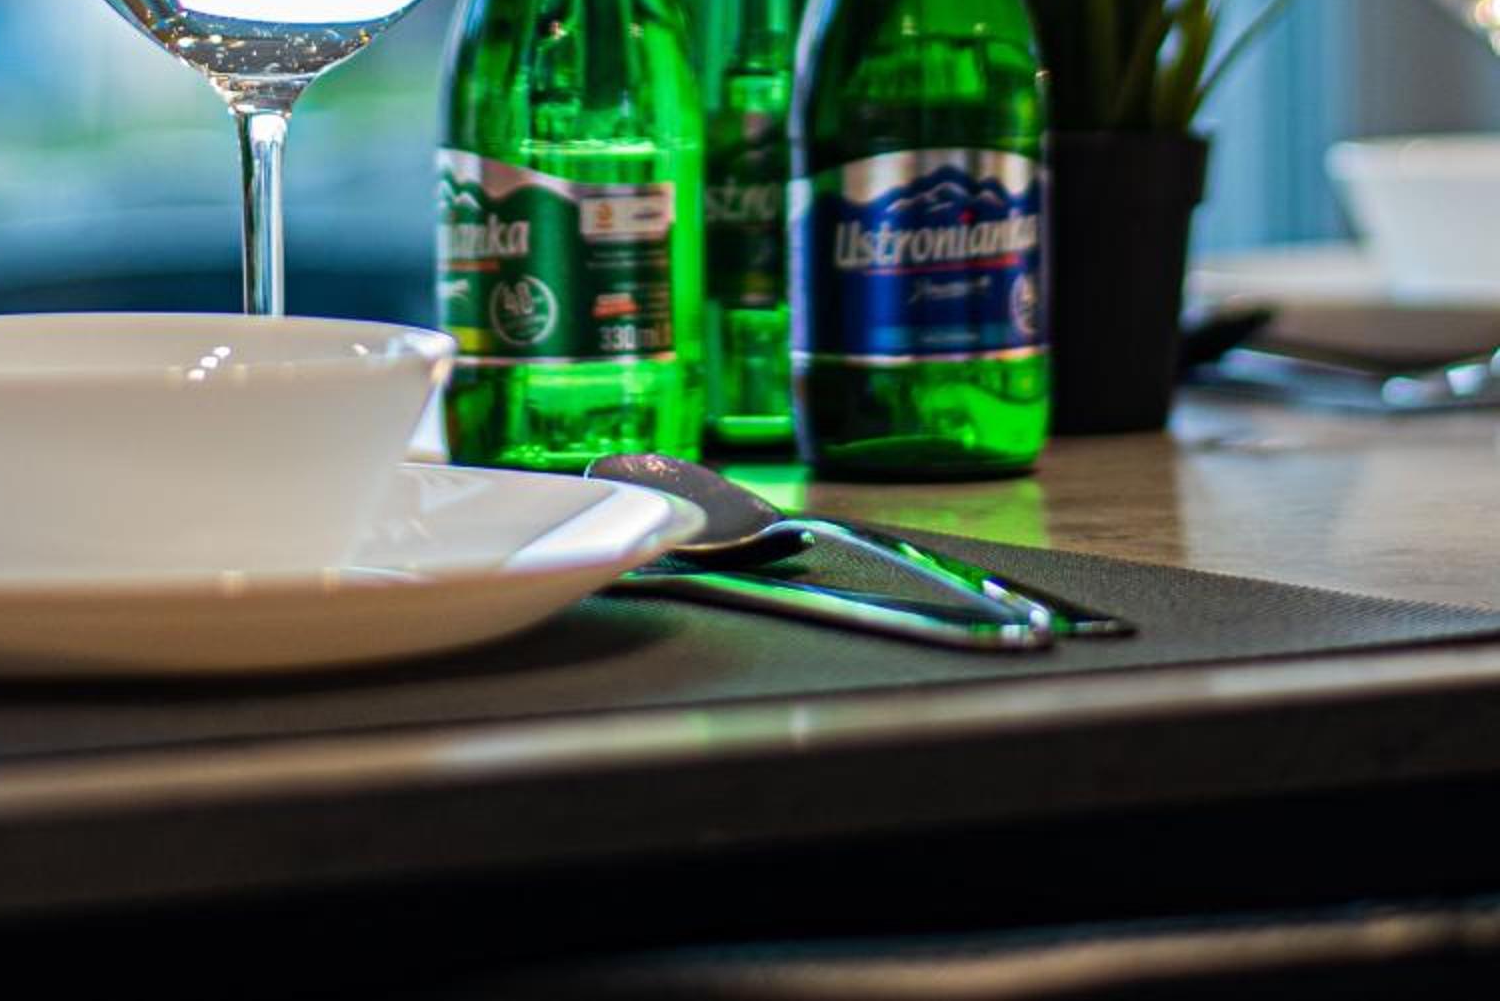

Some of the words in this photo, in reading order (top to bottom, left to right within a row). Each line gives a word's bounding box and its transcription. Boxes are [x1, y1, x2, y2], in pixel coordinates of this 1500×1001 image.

[706, 177, 784, 223] stro
[834, 212, 1039, 269] Ustronianka
[599, 324, 637, 351] 330
